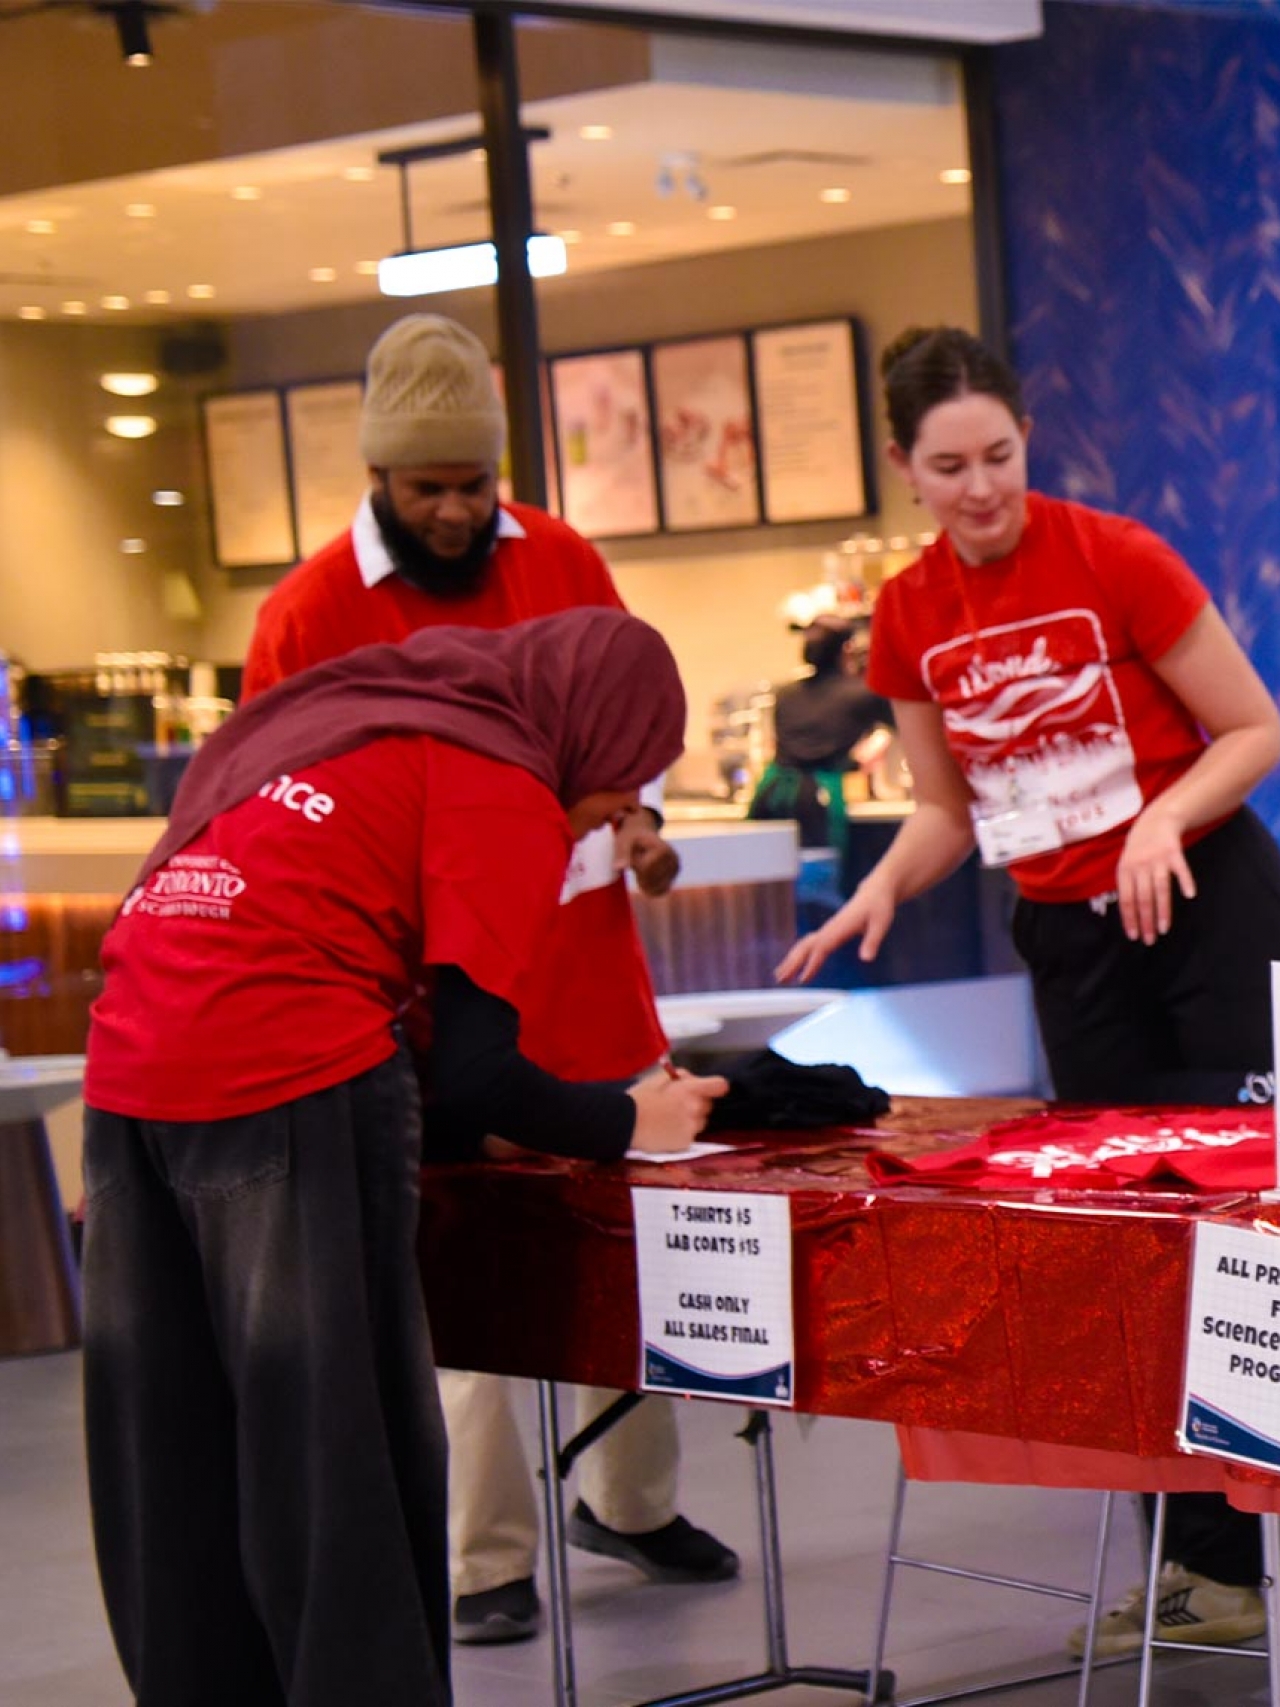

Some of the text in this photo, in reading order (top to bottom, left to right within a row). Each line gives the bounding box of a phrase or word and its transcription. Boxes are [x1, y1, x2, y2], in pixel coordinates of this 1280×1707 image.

[671, 1204, 733, 1225] T-SHIRTS
[665, 1233, 691, 1252] LAB
[693, 1235, 736, 1255] COATS
[1216, 1256, 1250, 1279] ALL
[678, 1292, 750, 1314] CASH ONLY
[663, 1320, 770, 1346] ALL SALES FINAL
[1202, 1315, 1280, 1350] SCIENCE
